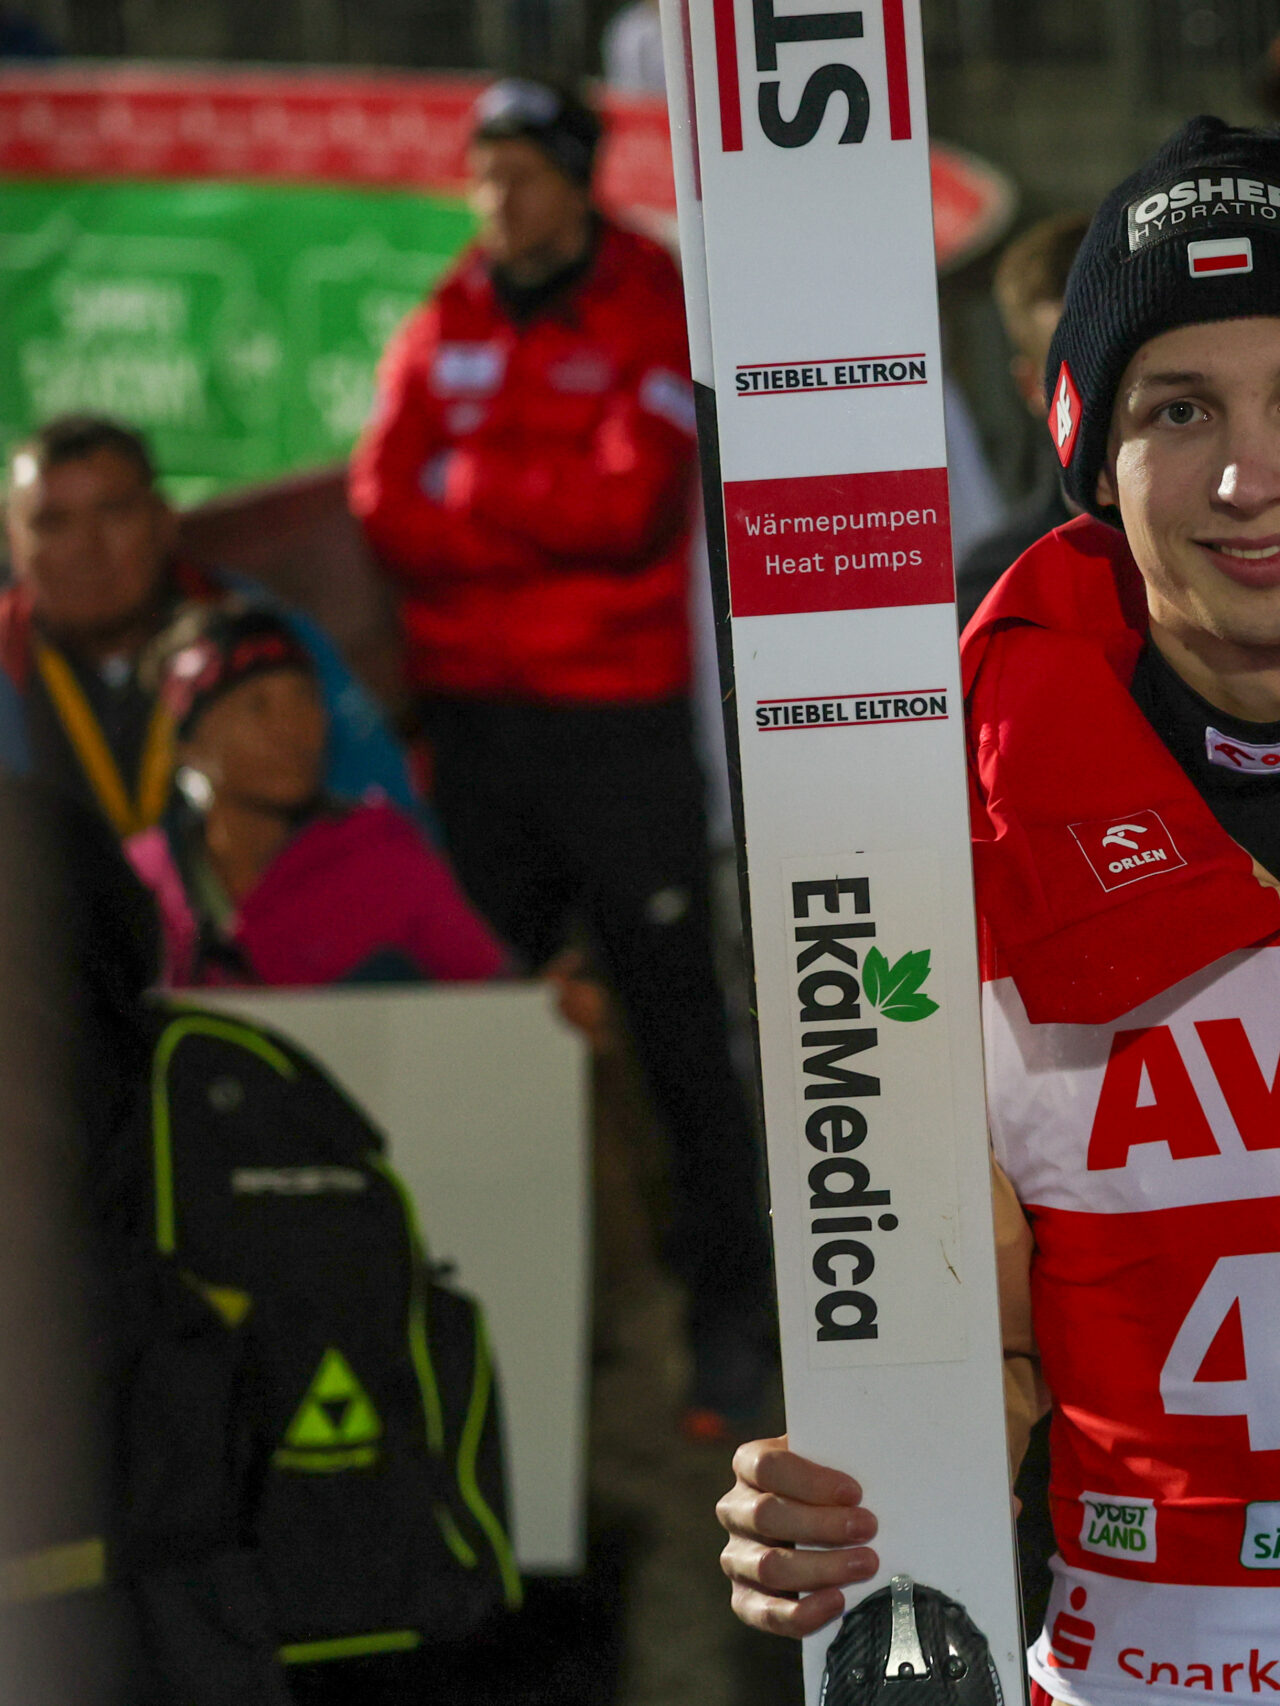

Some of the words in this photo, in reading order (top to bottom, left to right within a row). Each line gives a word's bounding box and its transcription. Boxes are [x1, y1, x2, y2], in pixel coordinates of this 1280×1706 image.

[735, 366, 828, 392] STIEBEL
[835, 360, 927, 385] ELTRON
[745, 508, 938, 540] Wärmepumpen
[765, 551, 825, 576] Heat
[834, 549, 923, 575] pumps
[755, 702, 849, 727] STIEBEL
[855, 695, 948, 721] ELTRON
[1108, 848, 1168, 873] ORLEN
[791, 876, 899, 1343] EkaMedica
[1085, 1500, 1148, 1527] VOGT
[1087, 1520, 1147, 1552] LAND
